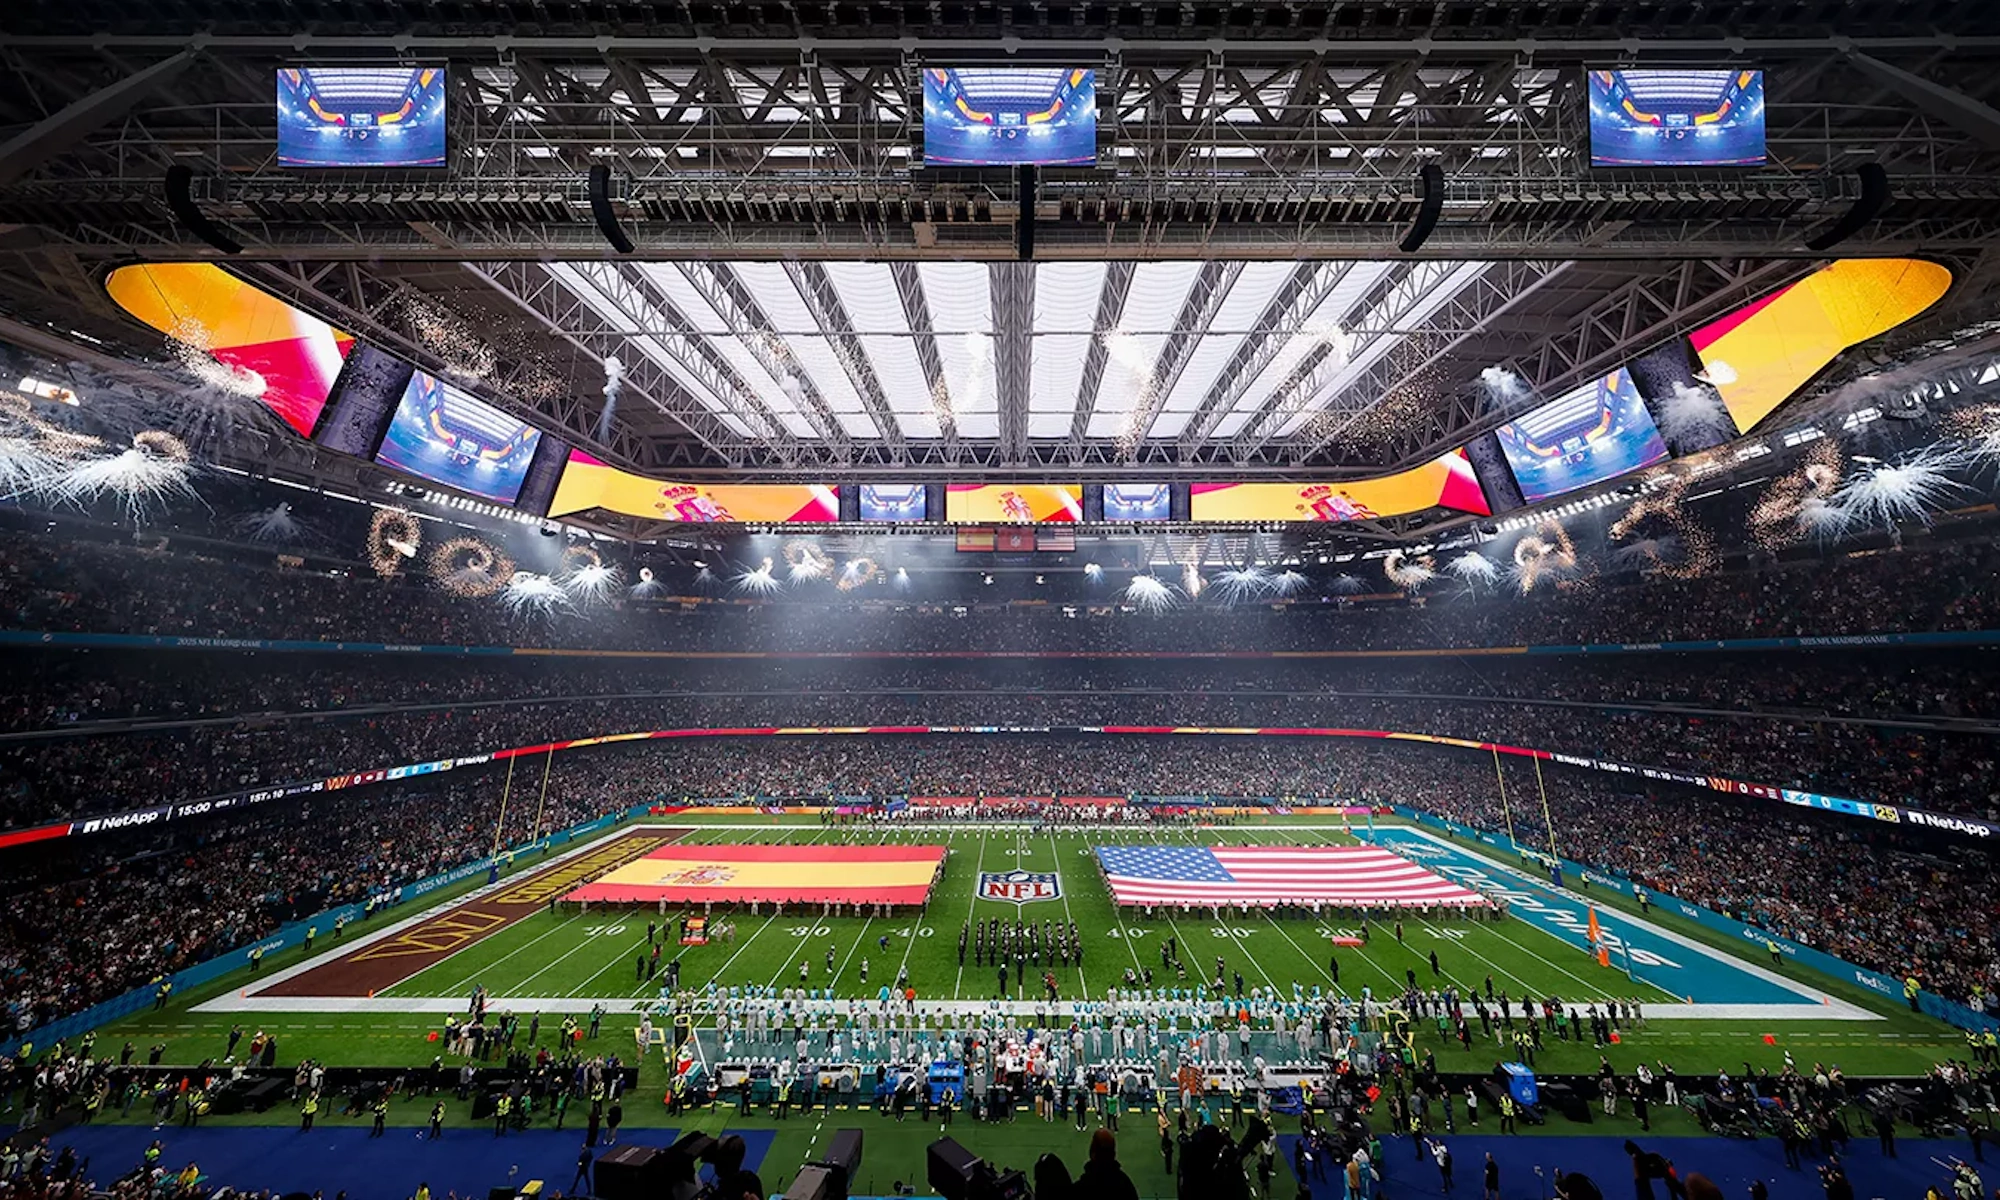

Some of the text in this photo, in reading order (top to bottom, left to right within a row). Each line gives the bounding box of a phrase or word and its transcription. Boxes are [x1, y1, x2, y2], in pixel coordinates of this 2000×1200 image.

[353, 775, 361, 785] 0
[250, 792, 268, 803] 1ST
[272, 789, 285, 799] 10
[311, 781, 324, 793] 35
[177, 802, 211, 817] 15:00
[1820, 796, 1896, 821] 0 25
[101, 811, 158, 831] NetApp
[1925, 814, 1990, 837] NetApp
[988, 883, 1051, 898] NFL
[1680, 905, 1699, 918] VISA
[790, 926, 831, 937] 30
[896, 926, 934, 937] 40
[1106, 927, 1144, 938] 40
[1210, 927, 1250, 938] 30
[1855, 971, 1891, 994] FedEx
